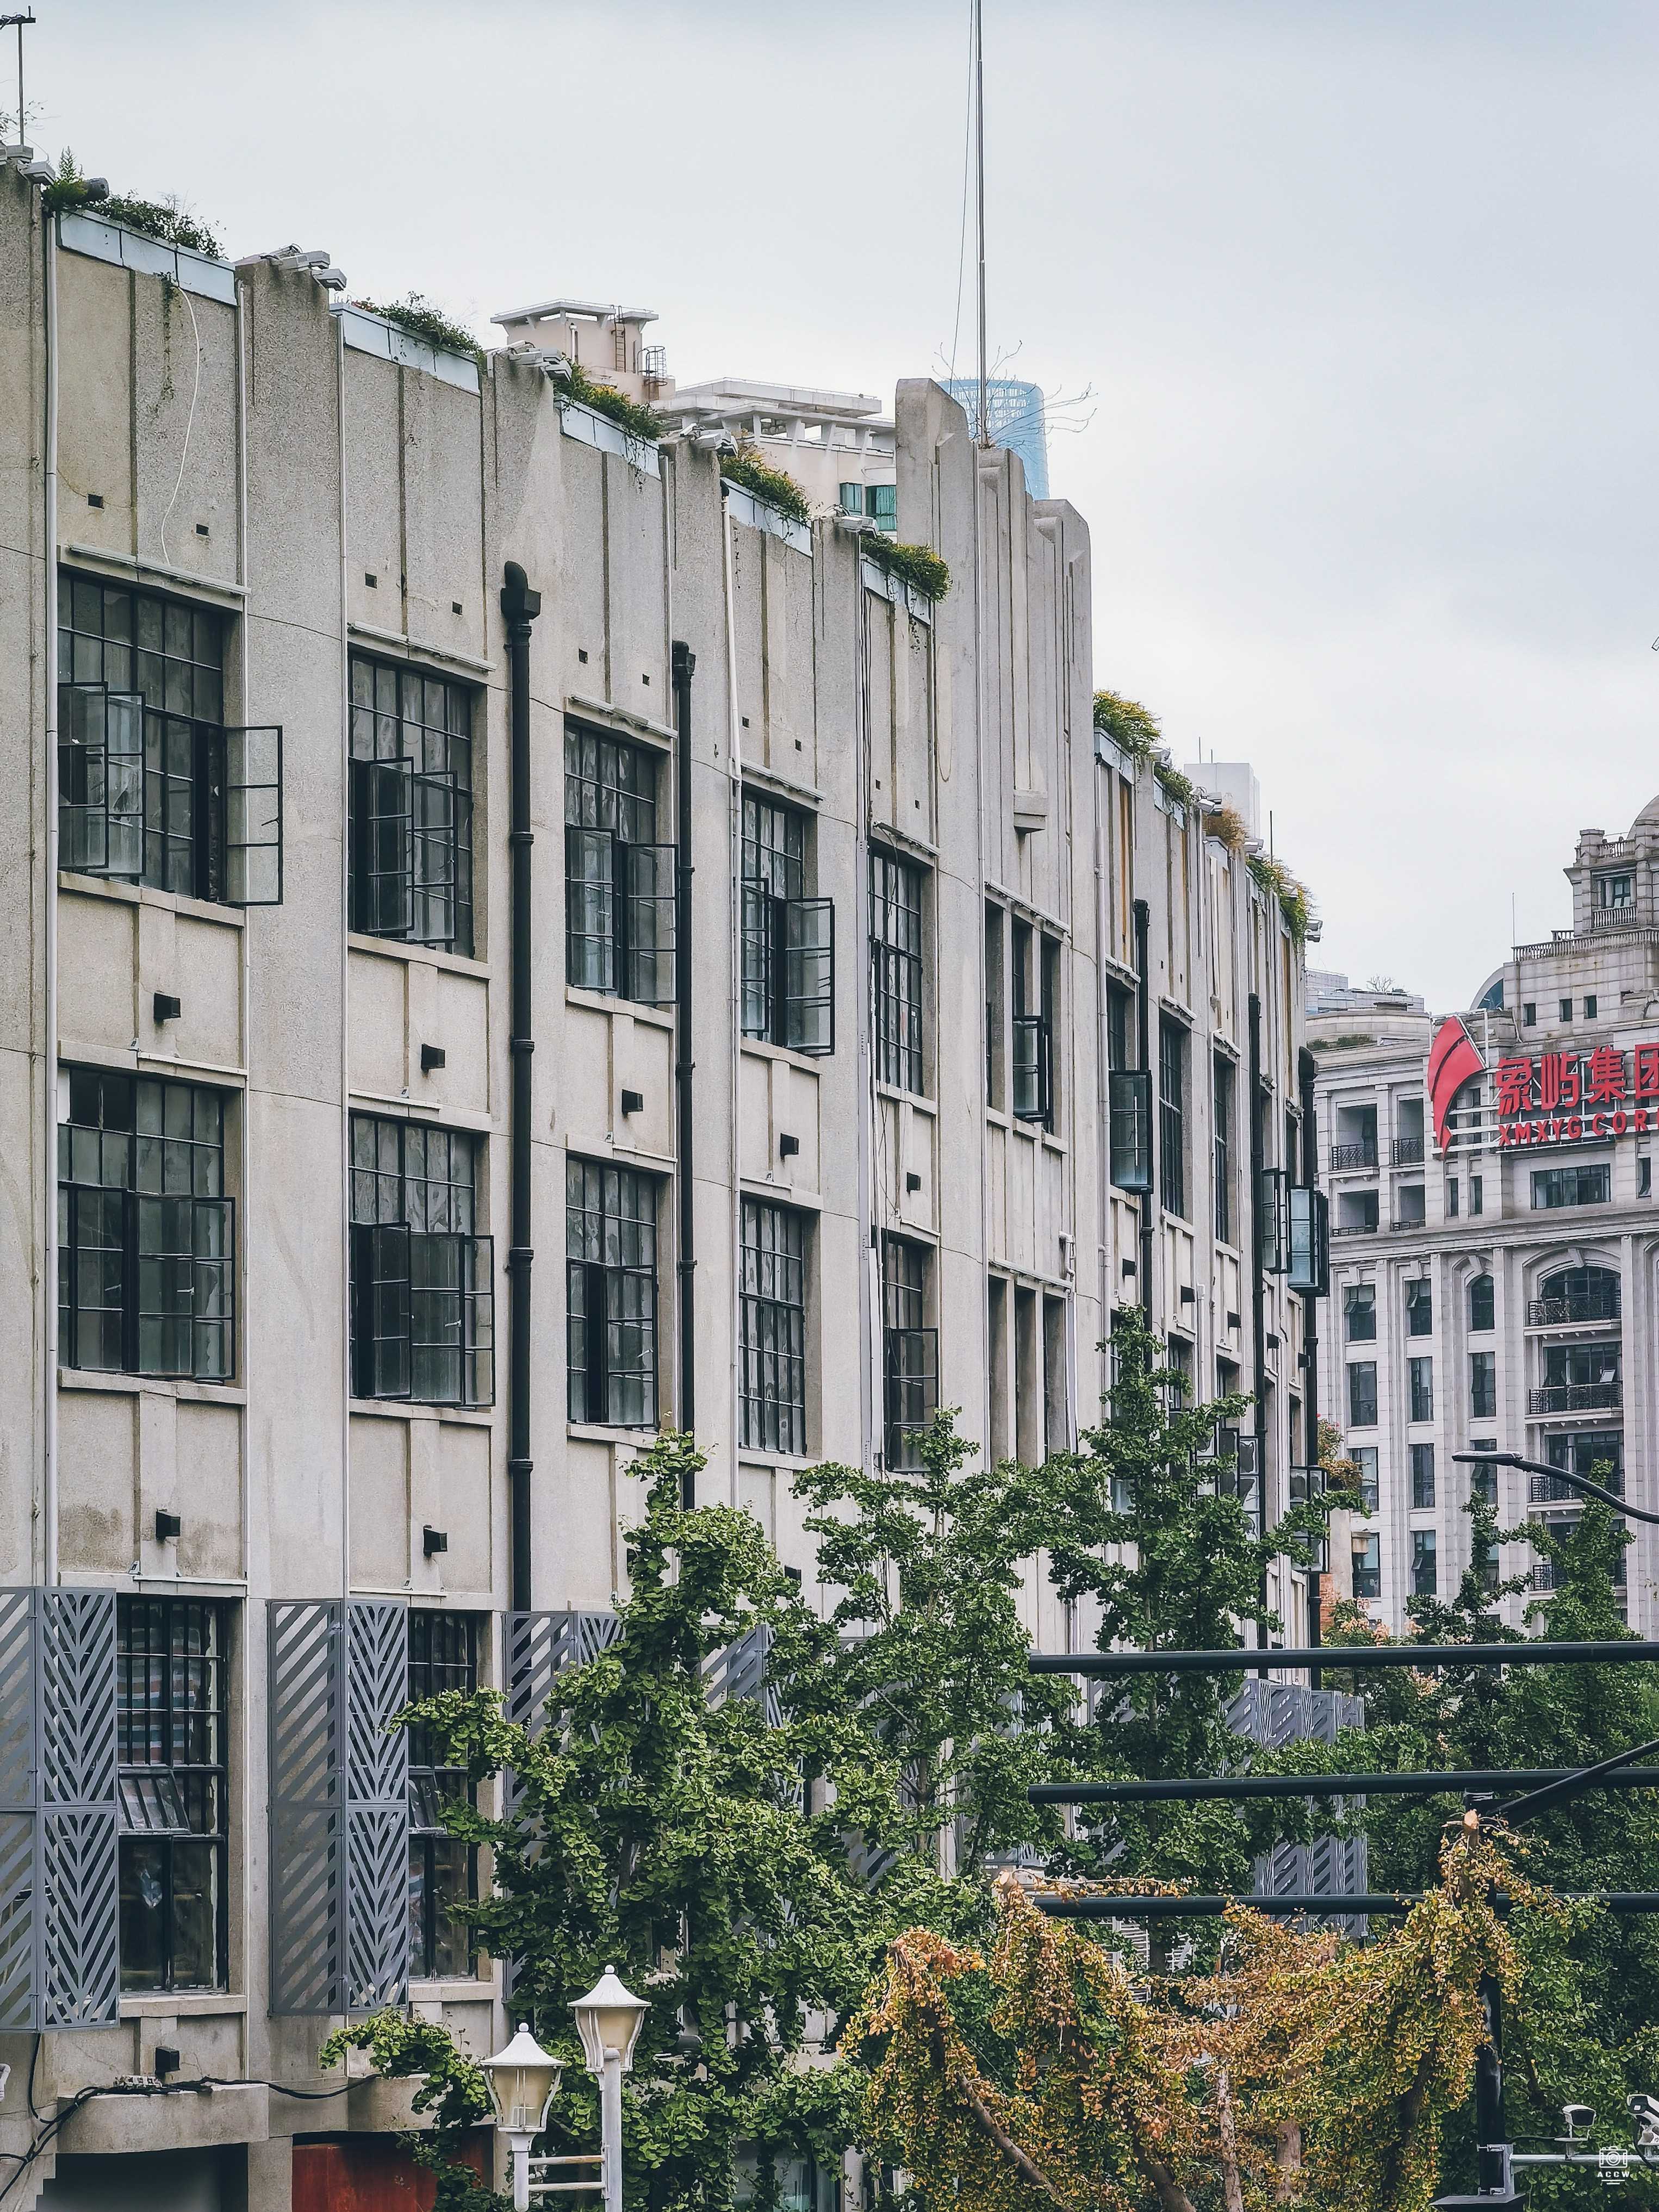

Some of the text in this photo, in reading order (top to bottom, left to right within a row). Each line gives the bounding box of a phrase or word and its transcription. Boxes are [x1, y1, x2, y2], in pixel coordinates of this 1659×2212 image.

[1495, 1042, 1659, 1116] 象屿集团
[1498, 1108, 1659, 1146] XMXYG COR
